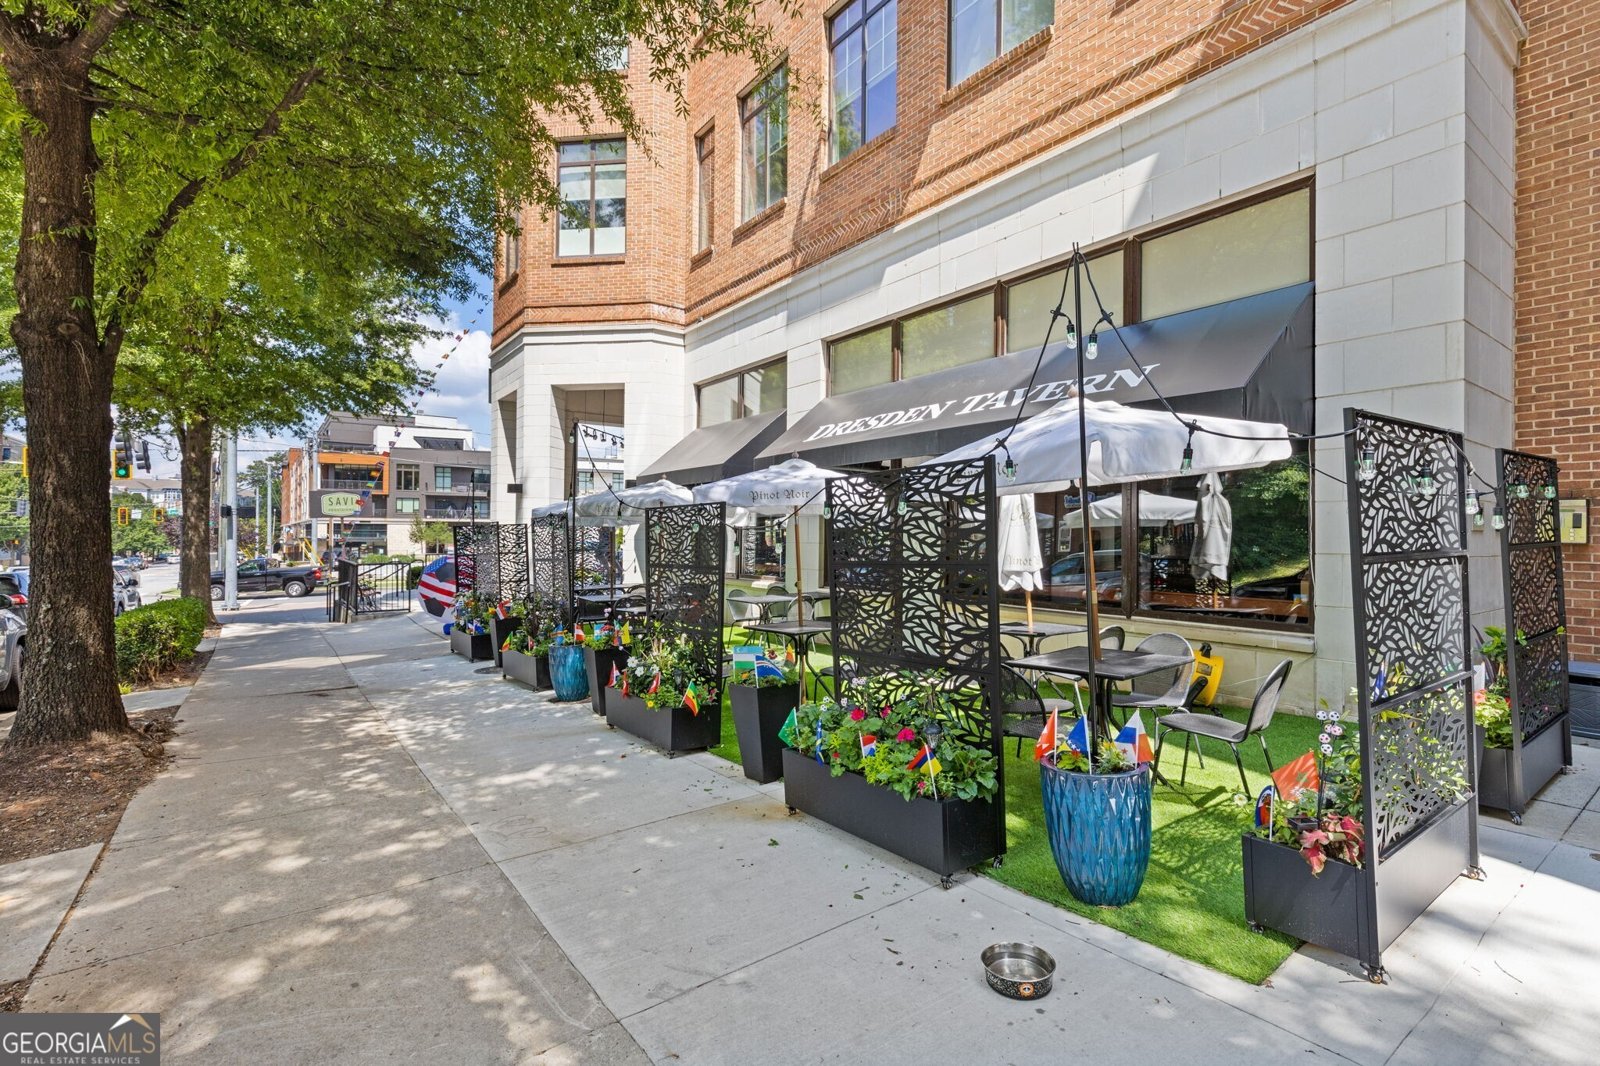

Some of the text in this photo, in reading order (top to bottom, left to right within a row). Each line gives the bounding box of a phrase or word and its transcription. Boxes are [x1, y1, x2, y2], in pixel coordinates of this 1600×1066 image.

[803, 363, 1160, 442] DRESDEN TAVERN
[328, 497, 354, 506] SAVI
[749, 489, 810, 503] Pinot Noir
